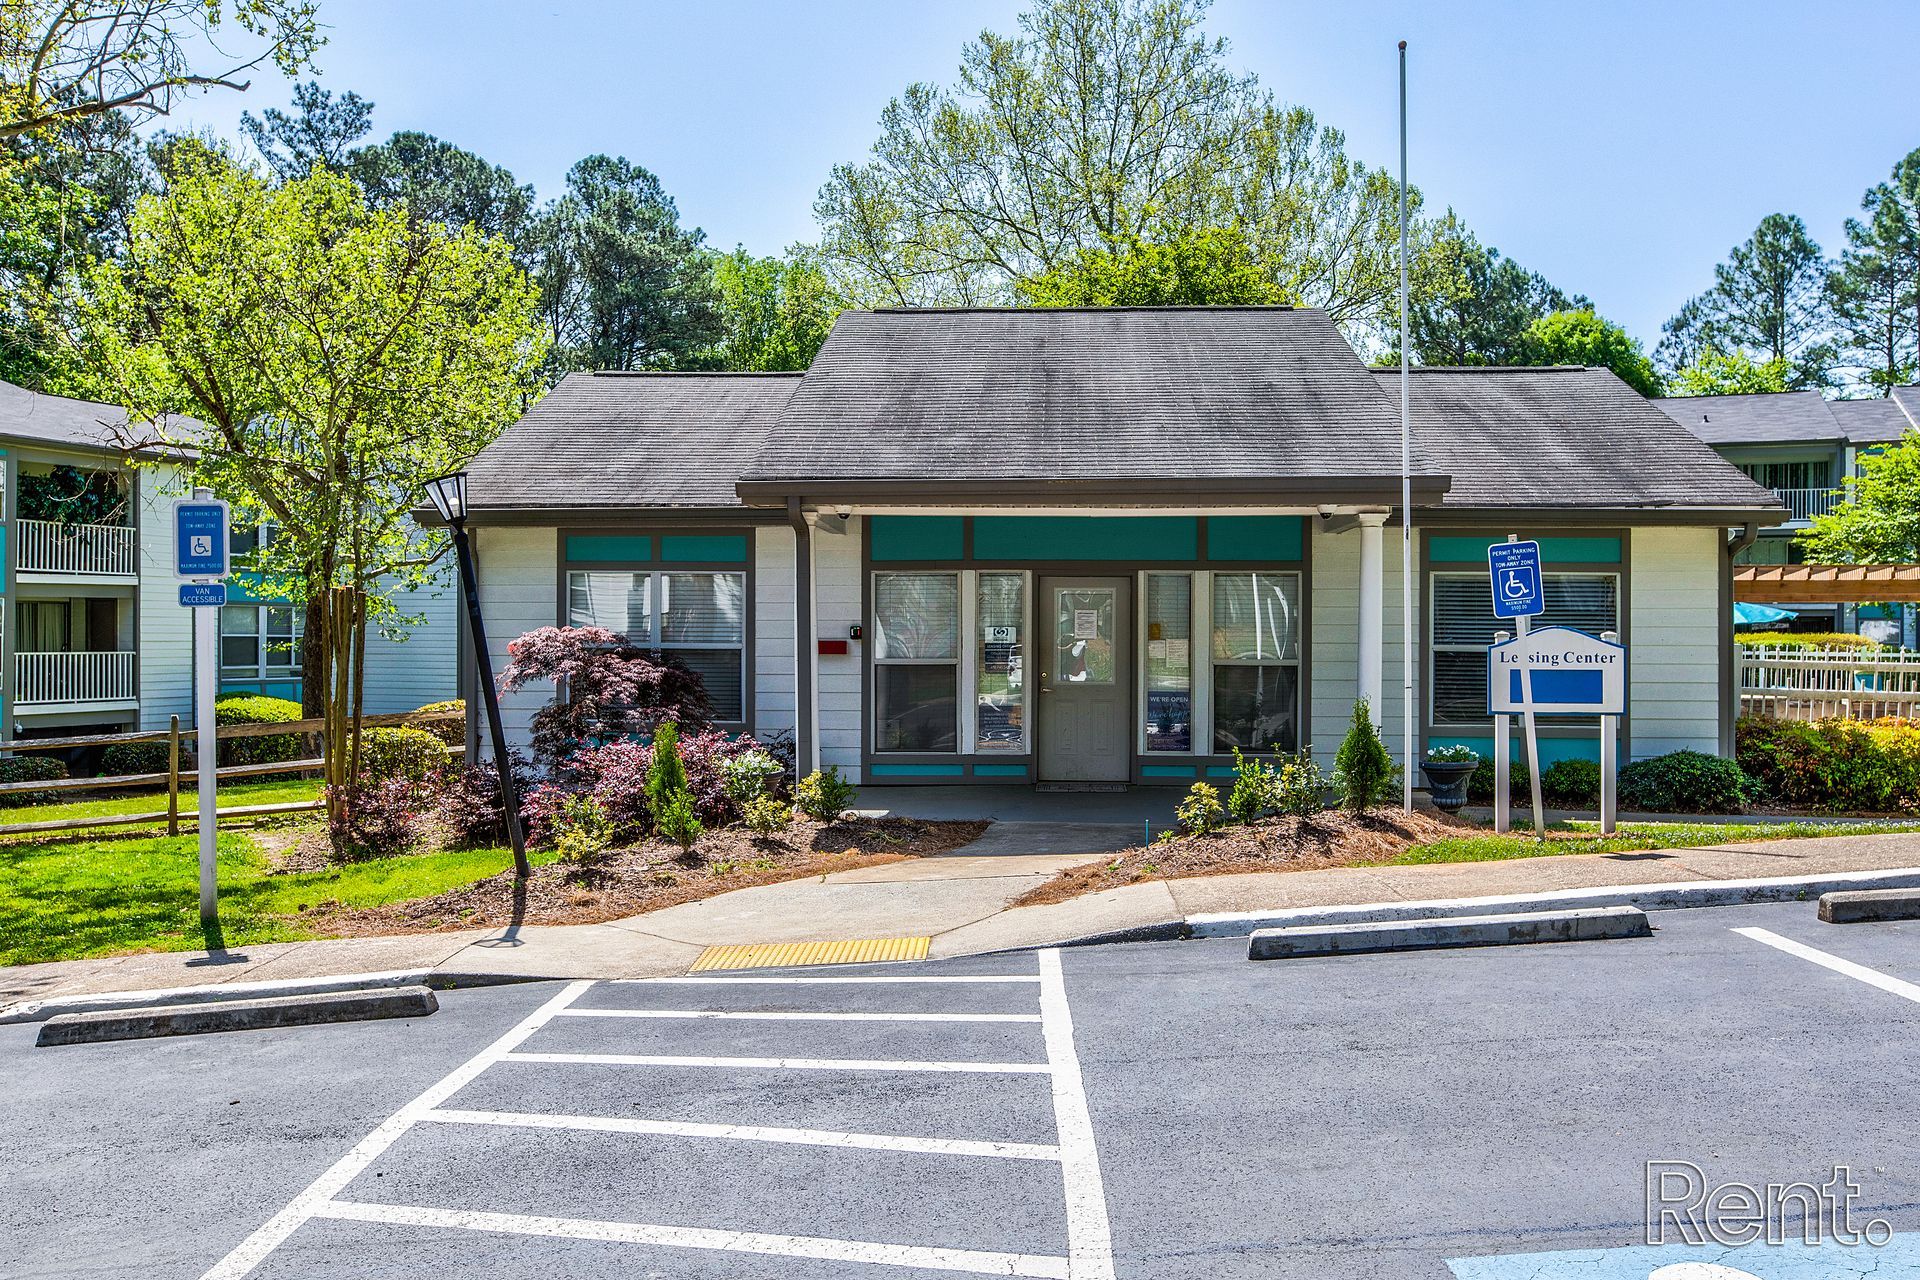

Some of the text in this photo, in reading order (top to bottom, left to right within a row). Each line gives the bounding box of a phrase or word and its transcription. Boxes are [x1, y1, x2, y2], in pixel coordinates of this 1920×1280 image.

[182, 596, 223, 604] ACCESSIBLE
[1500, 651, 1617, 666] Lesing Center
